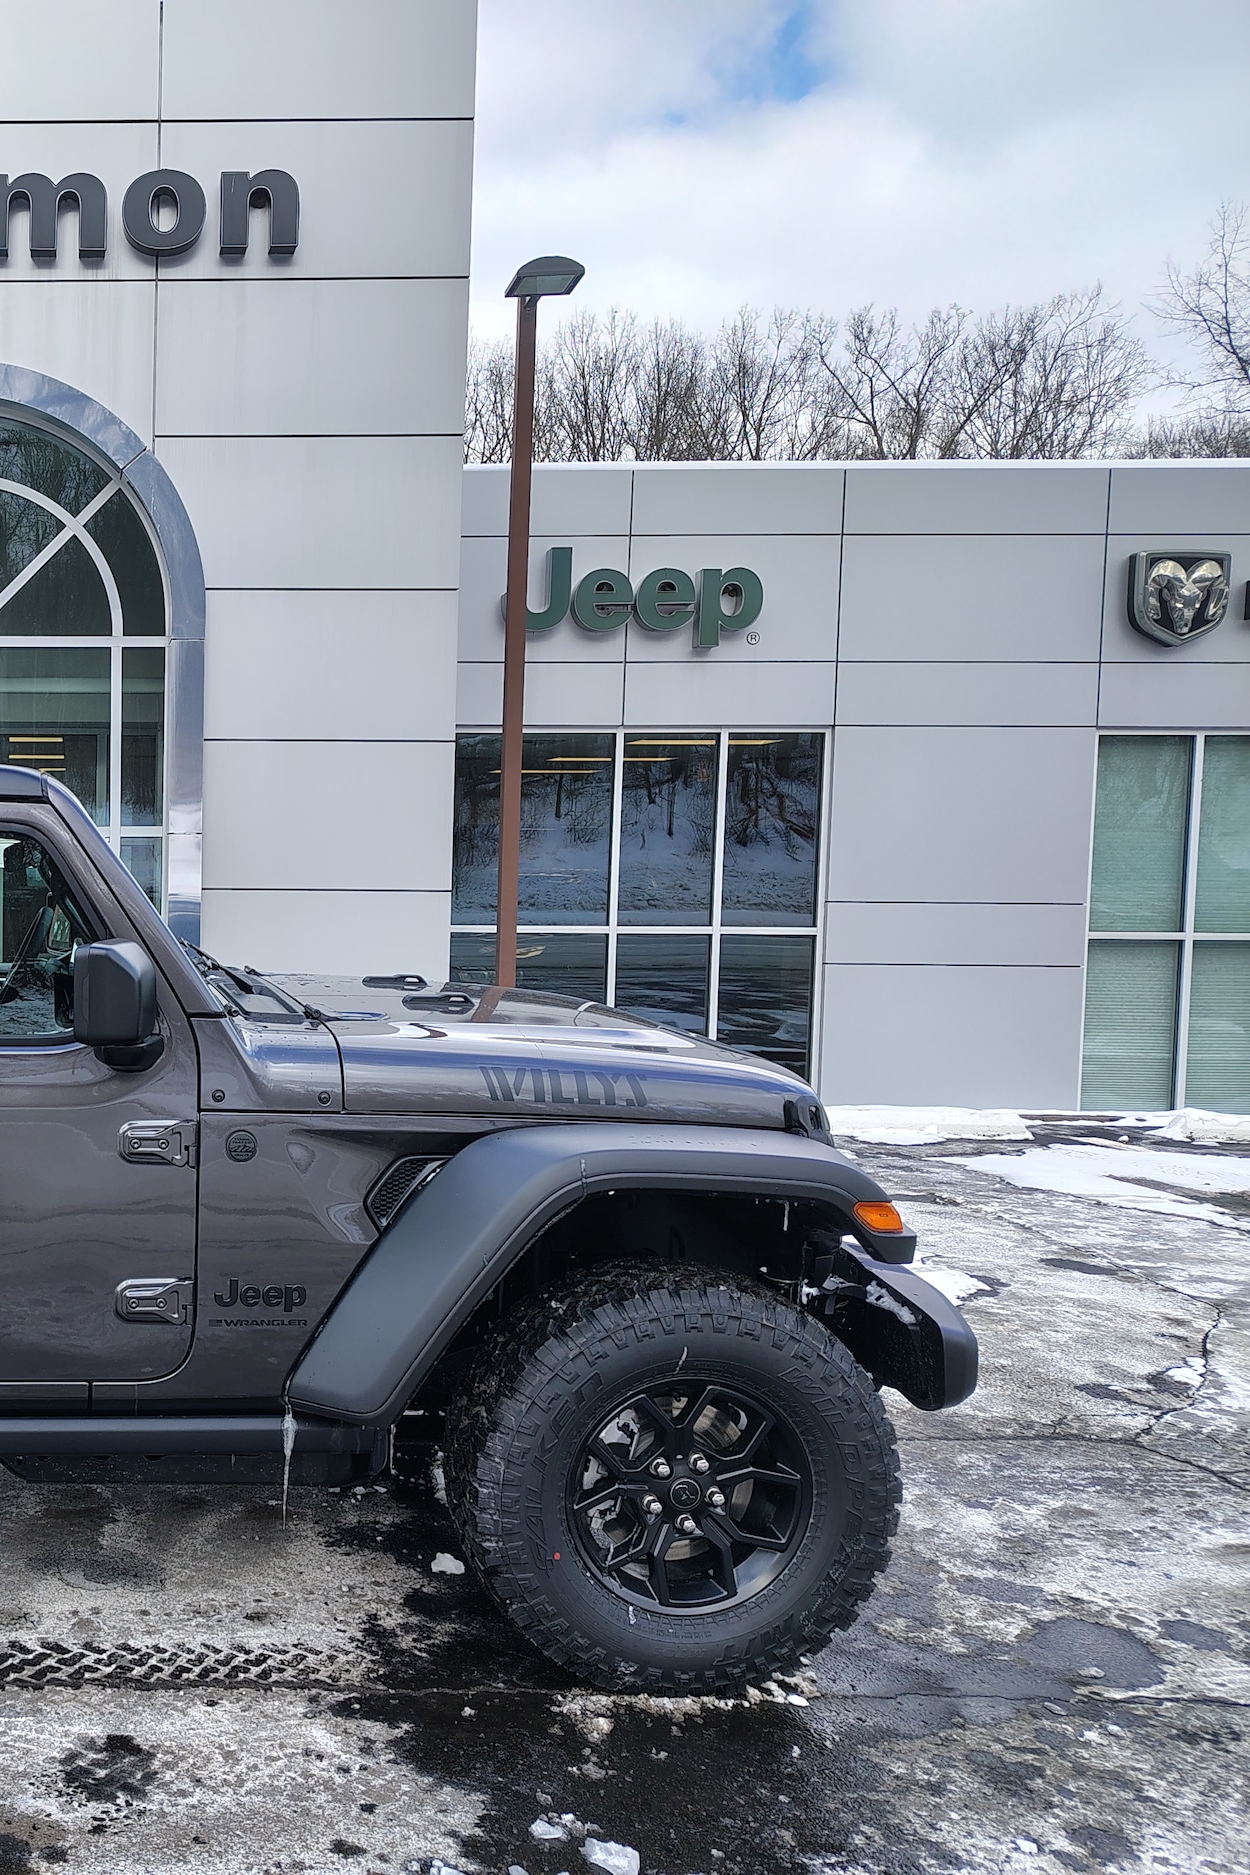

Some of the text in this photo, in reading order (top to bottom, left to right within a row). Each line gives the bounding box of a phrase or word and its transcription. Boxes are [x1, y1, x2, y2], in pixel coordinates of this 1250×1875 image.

[501, 547, 764, 649] Jeep
[479, 1066, 648, 1107] WILLYS
[213, 1277, 307, 1312] Jeep
[222, 1319, 308, 1327] WRANGLER
